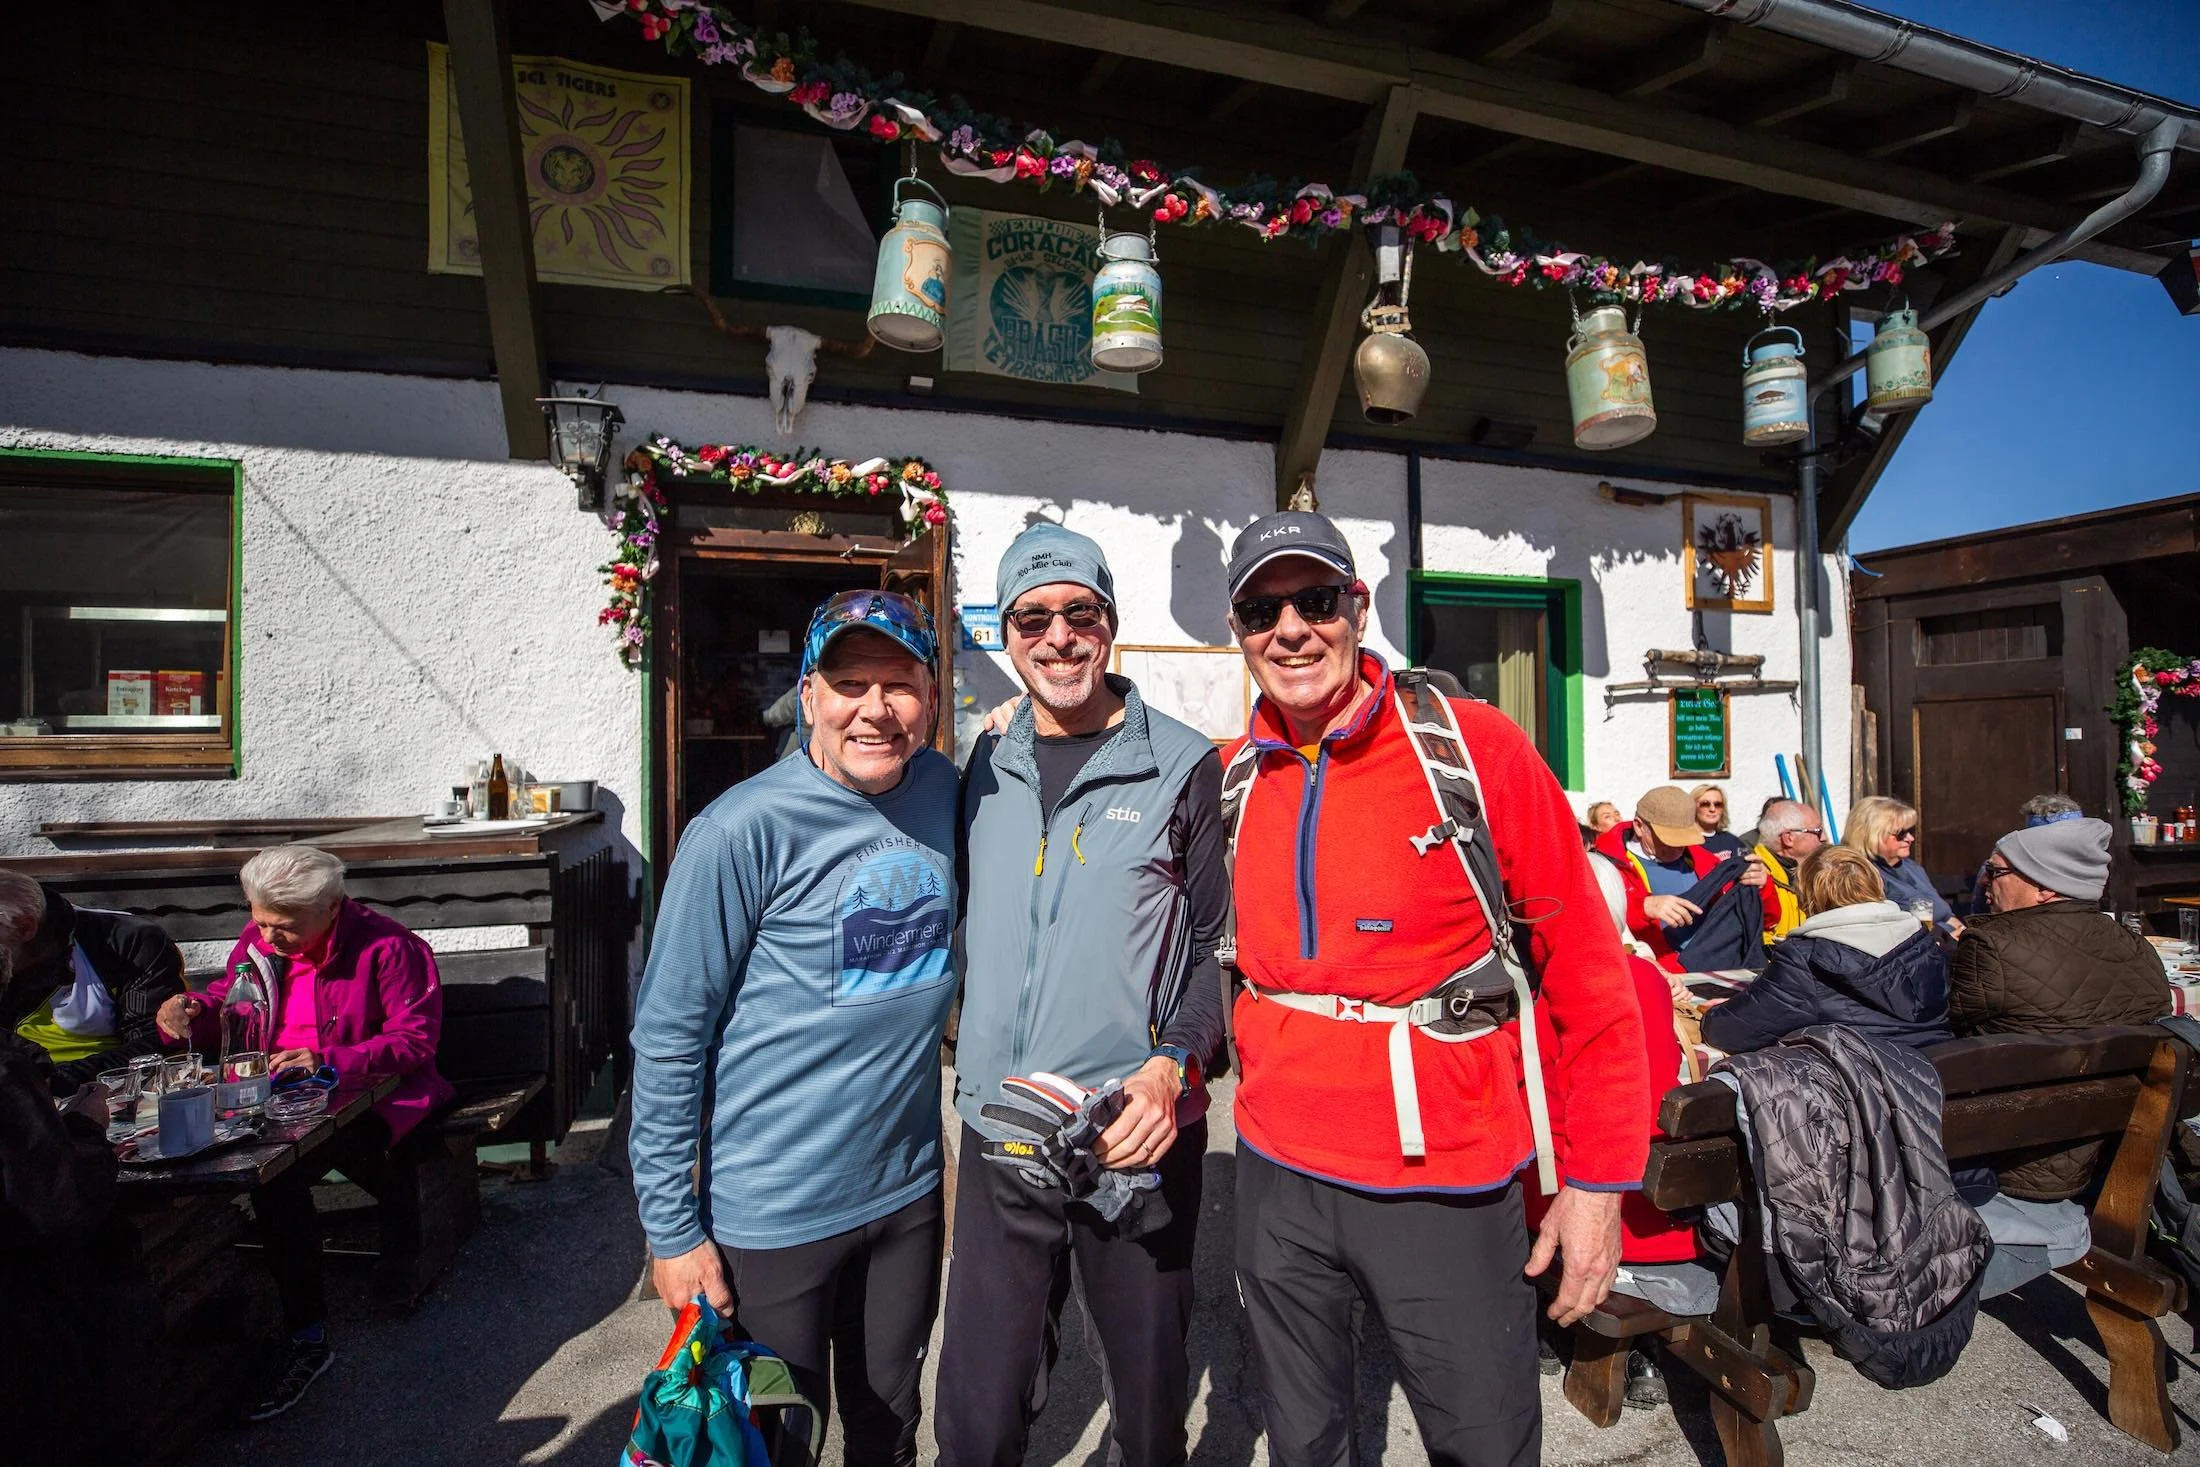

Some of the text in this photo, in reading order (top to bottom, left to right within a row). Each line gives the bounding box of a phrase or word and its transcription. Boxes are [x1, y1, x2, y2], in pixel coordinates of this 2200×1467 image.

[556, 72, 616, 97] TIGERS
[1260, 526, 1301, 542] KKR
[1031, 552, 1052, 562] NMH
[1052, 559, 1072, 567] Club
[974, 630, 990, 642] 61
[165, 686, 193, 695] Ketchup
[1106, 806, 1142, 824] stio
[856, 837, 921, 862] FINISHER
[852, 922, 944, 954] Windermere
[1003, 1141, 1035, 1155] TOKO
